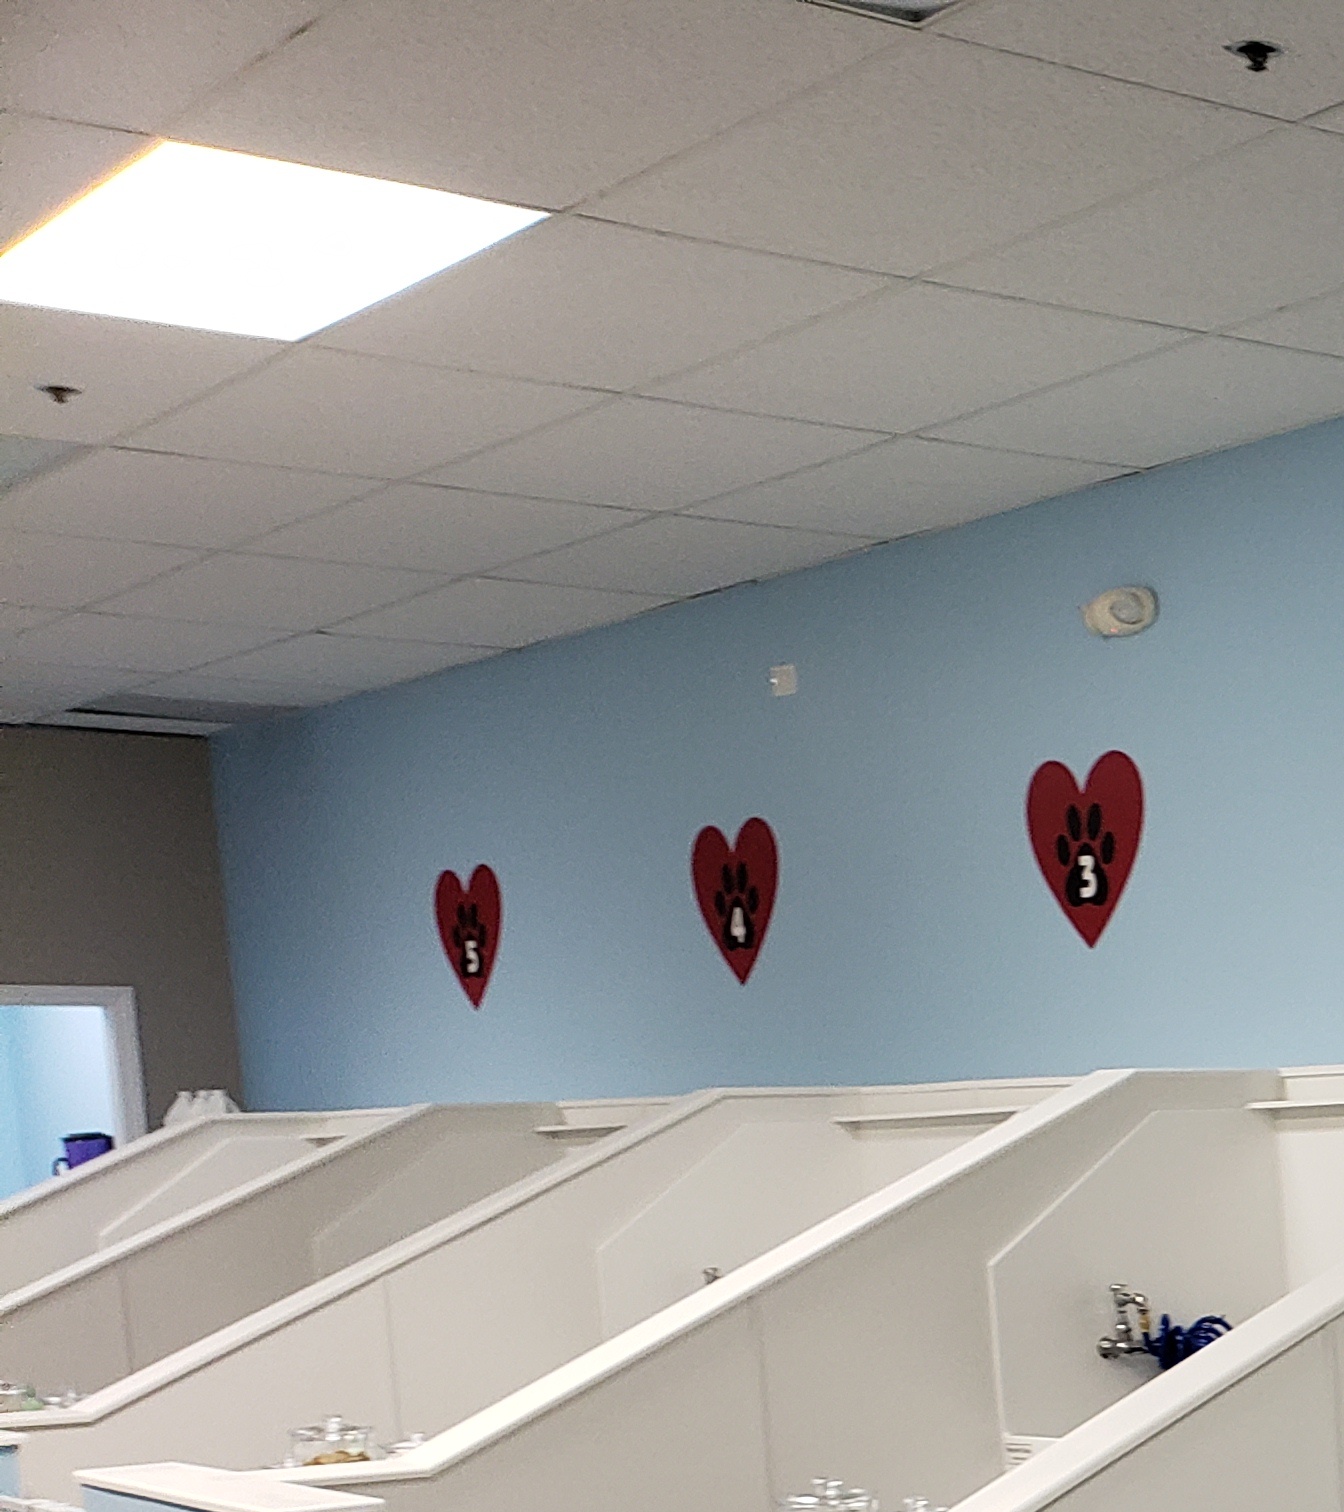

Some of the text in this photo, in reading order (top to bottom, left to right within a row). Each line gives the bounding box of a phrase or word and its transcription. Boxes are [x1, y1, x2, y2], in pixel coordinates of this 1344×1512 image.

[1077, 855, 1099, 898] 3
[730, 906, 747, 943] 4
[464, 940, 480, 973] 5
